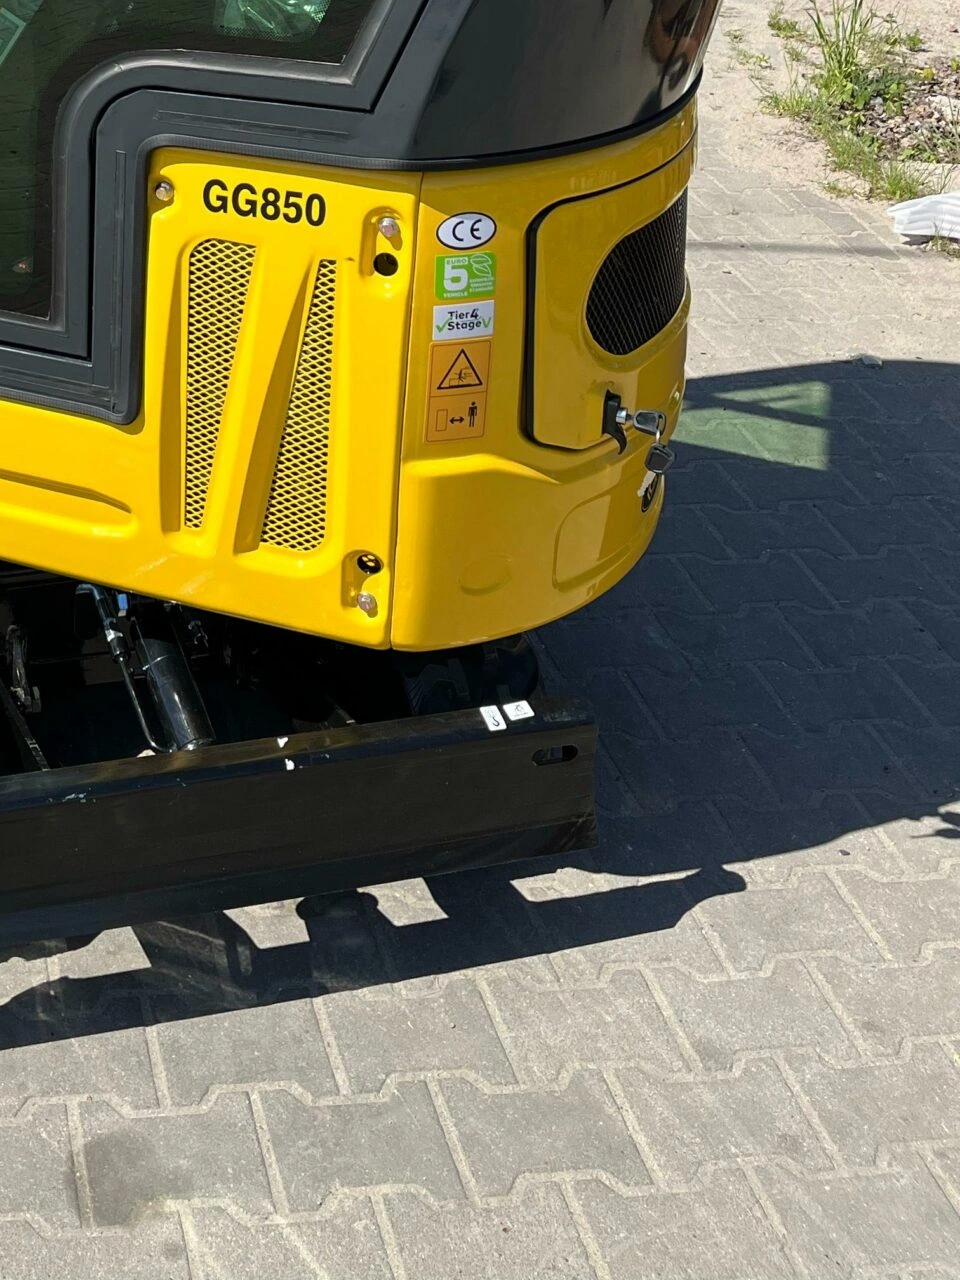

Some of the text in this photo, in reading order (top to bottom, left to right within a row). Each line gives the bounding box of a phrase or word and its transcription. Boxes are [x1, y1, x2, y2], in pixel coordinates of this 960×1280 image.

[203, 179, 326, 227] GG850
[452, 218, 482, 242] CE
[447, 320, 482, 331] Stage
